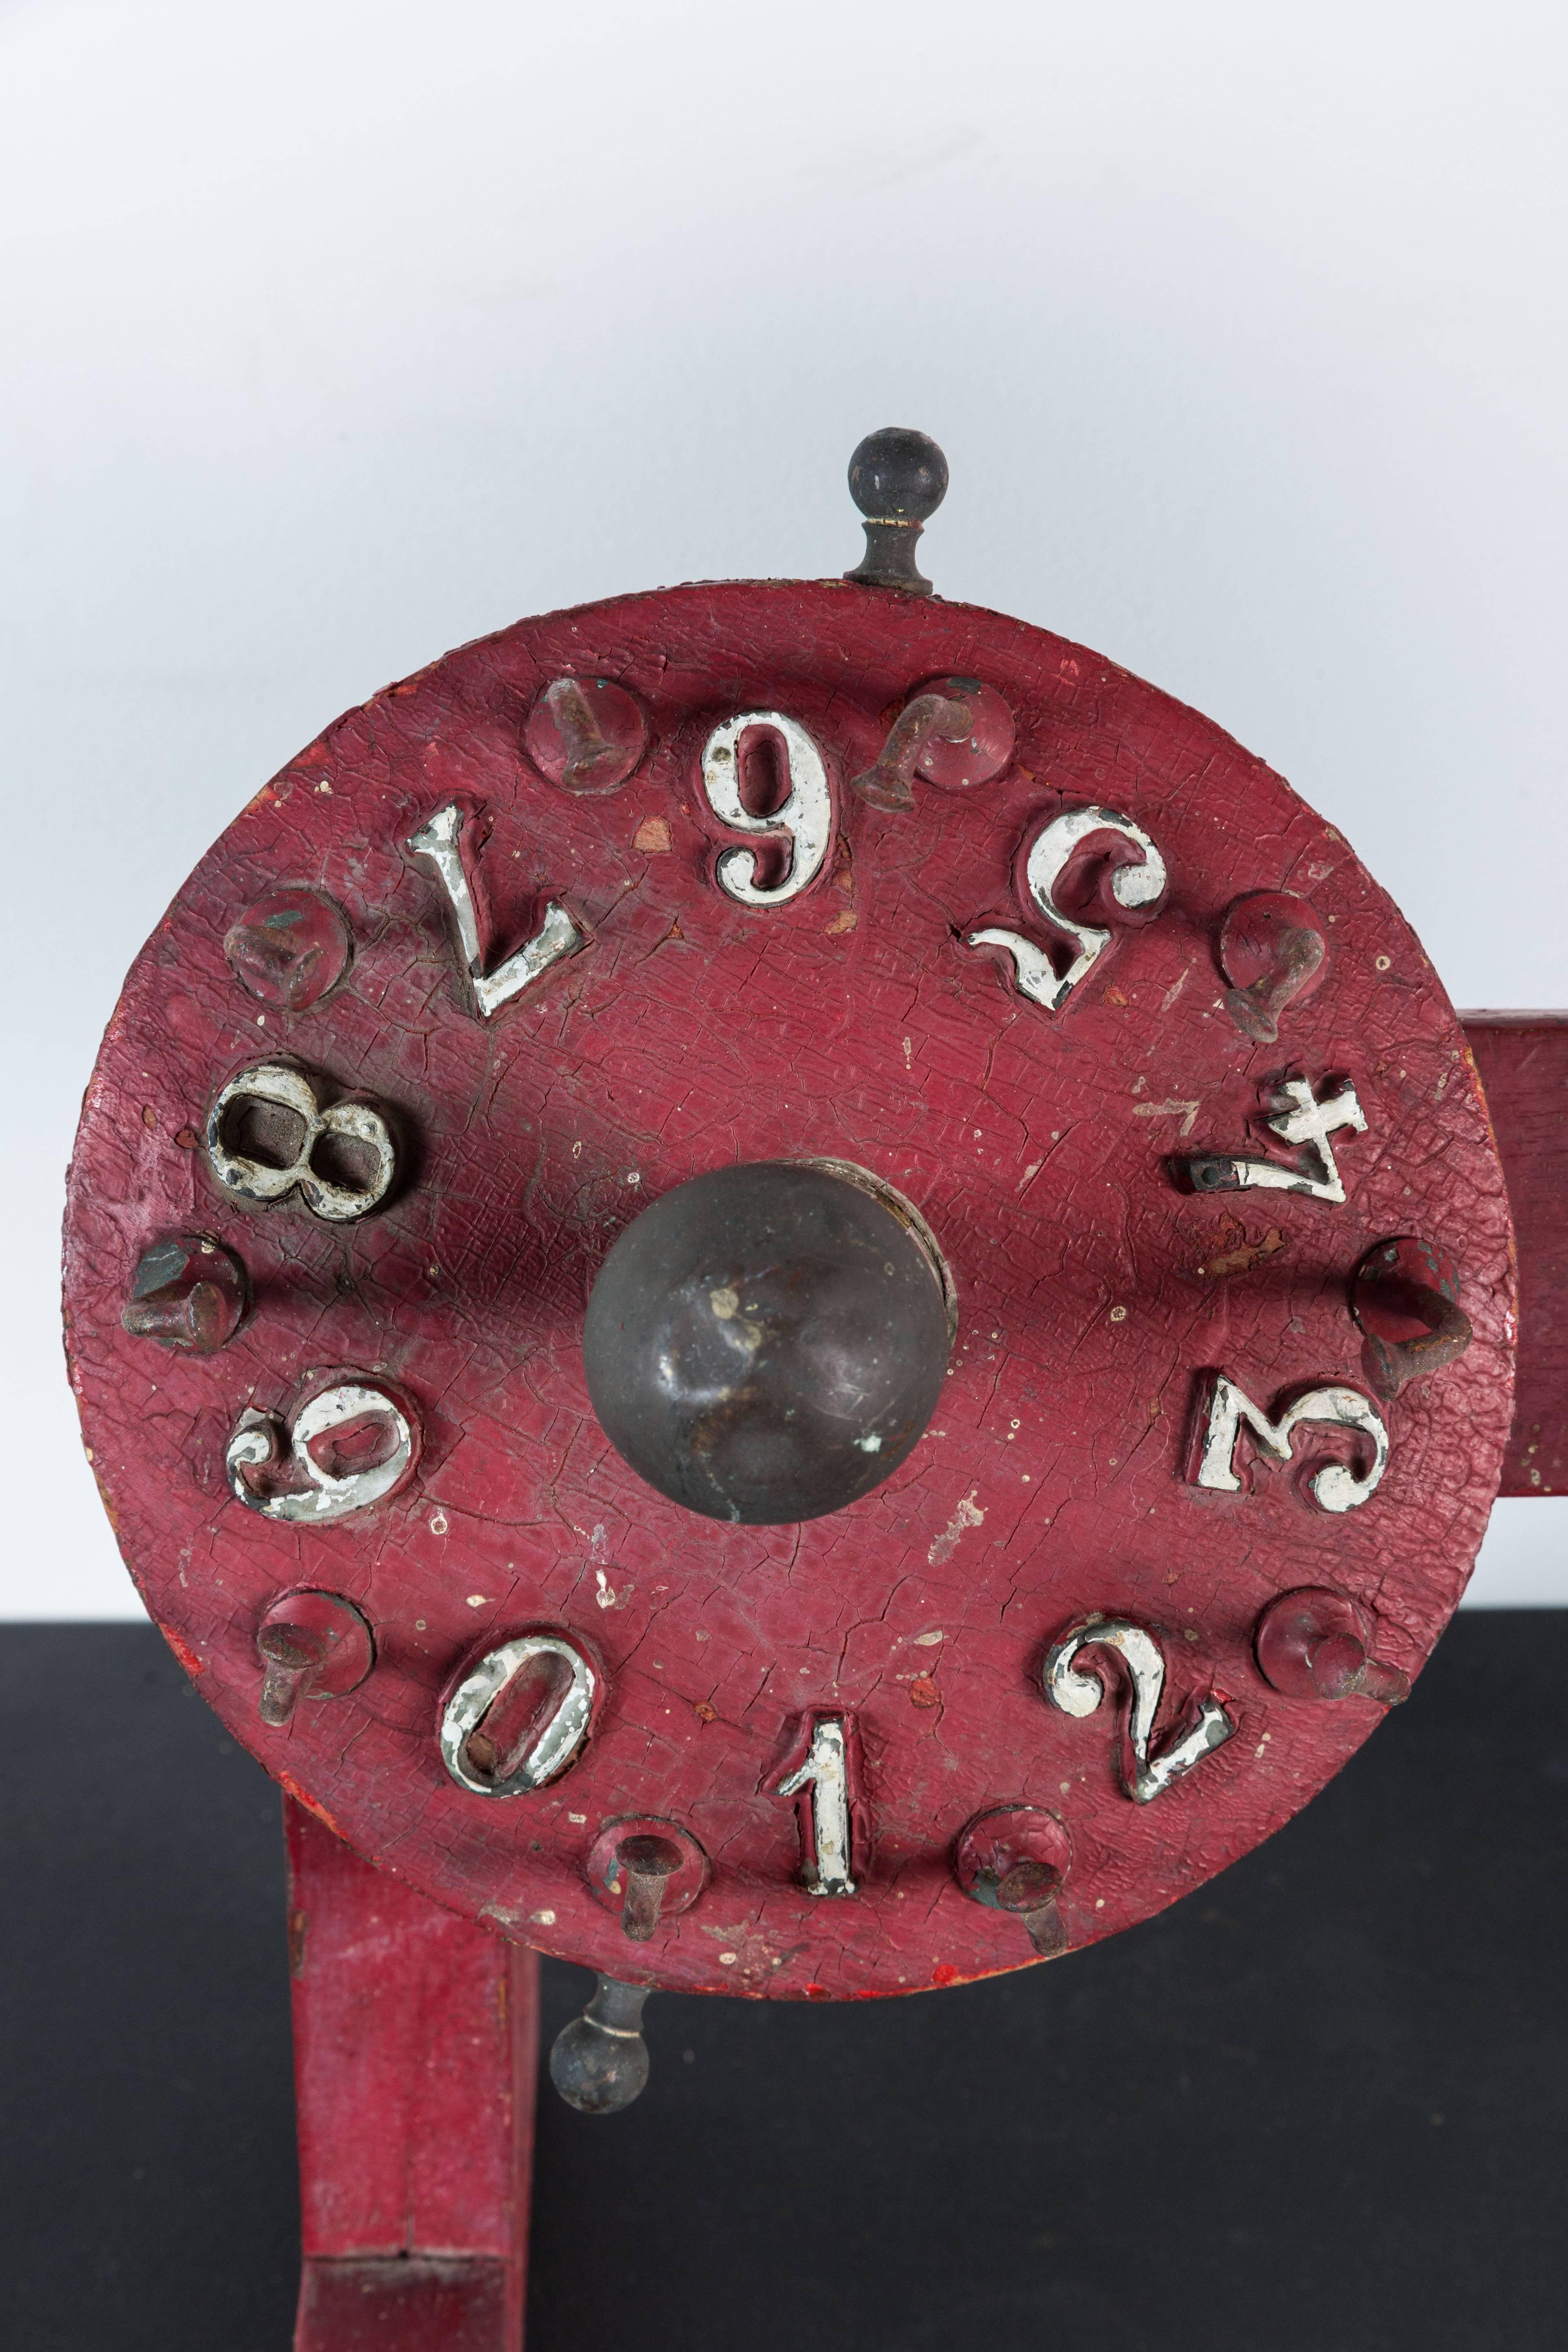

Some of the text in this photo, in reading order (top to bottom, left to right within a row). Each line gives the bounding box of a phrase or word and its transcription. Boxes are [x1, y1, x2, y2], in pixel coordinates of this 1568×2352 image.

[967, 806, 1166, 1011] 5
[209, 1062, 395, 1221] 8
[1188, 1076, 1367, 1203] 4
[1198, 1374, 1389, 1513] 3
[442, 1636, 595, 1797] 0
[1045, 1617, 1234, 1804] 2
[774, 1716, 857, 1895] 1
